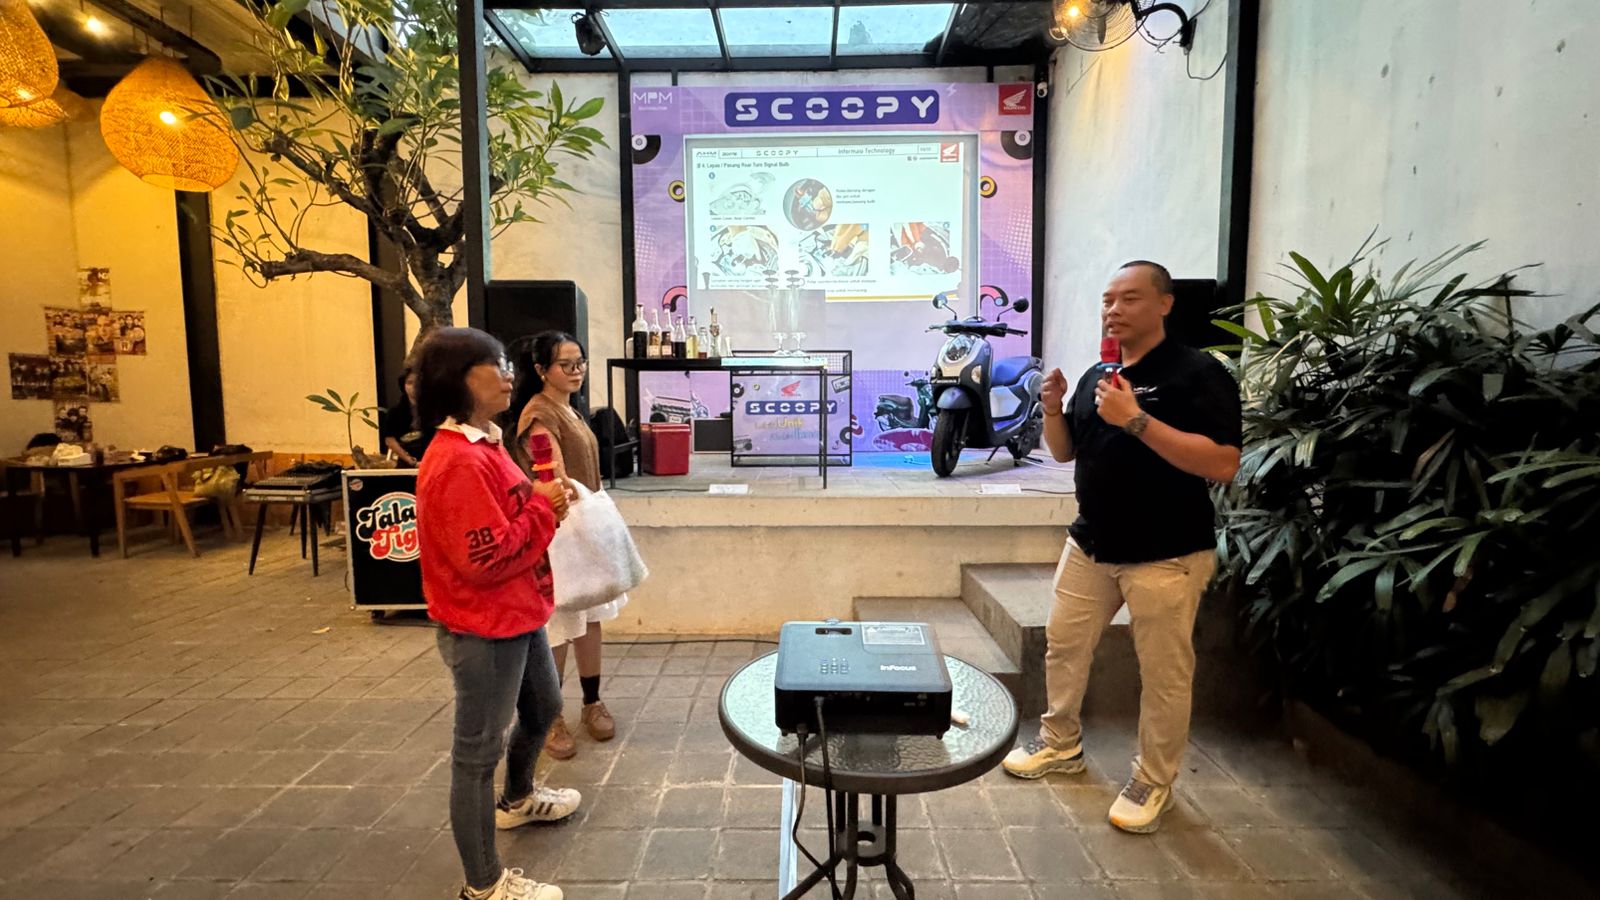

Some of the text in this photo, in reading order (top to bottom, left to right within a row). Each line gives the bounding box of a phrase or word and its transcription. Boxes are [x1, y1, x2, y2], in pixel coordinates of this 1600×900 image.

[632, 91, 673, 105] MPM
[735, 95, 935, 121] SCOOPY
[756, 149, 799, 157] SCOOPY
[865, 147, 896, 155] Technology
[749, 402, 835, 413] SCOOPY
[357, 501, 417, 540] Tala
[372, 526, 419, 558] Tig
[465, 526, 496, 550] 38
